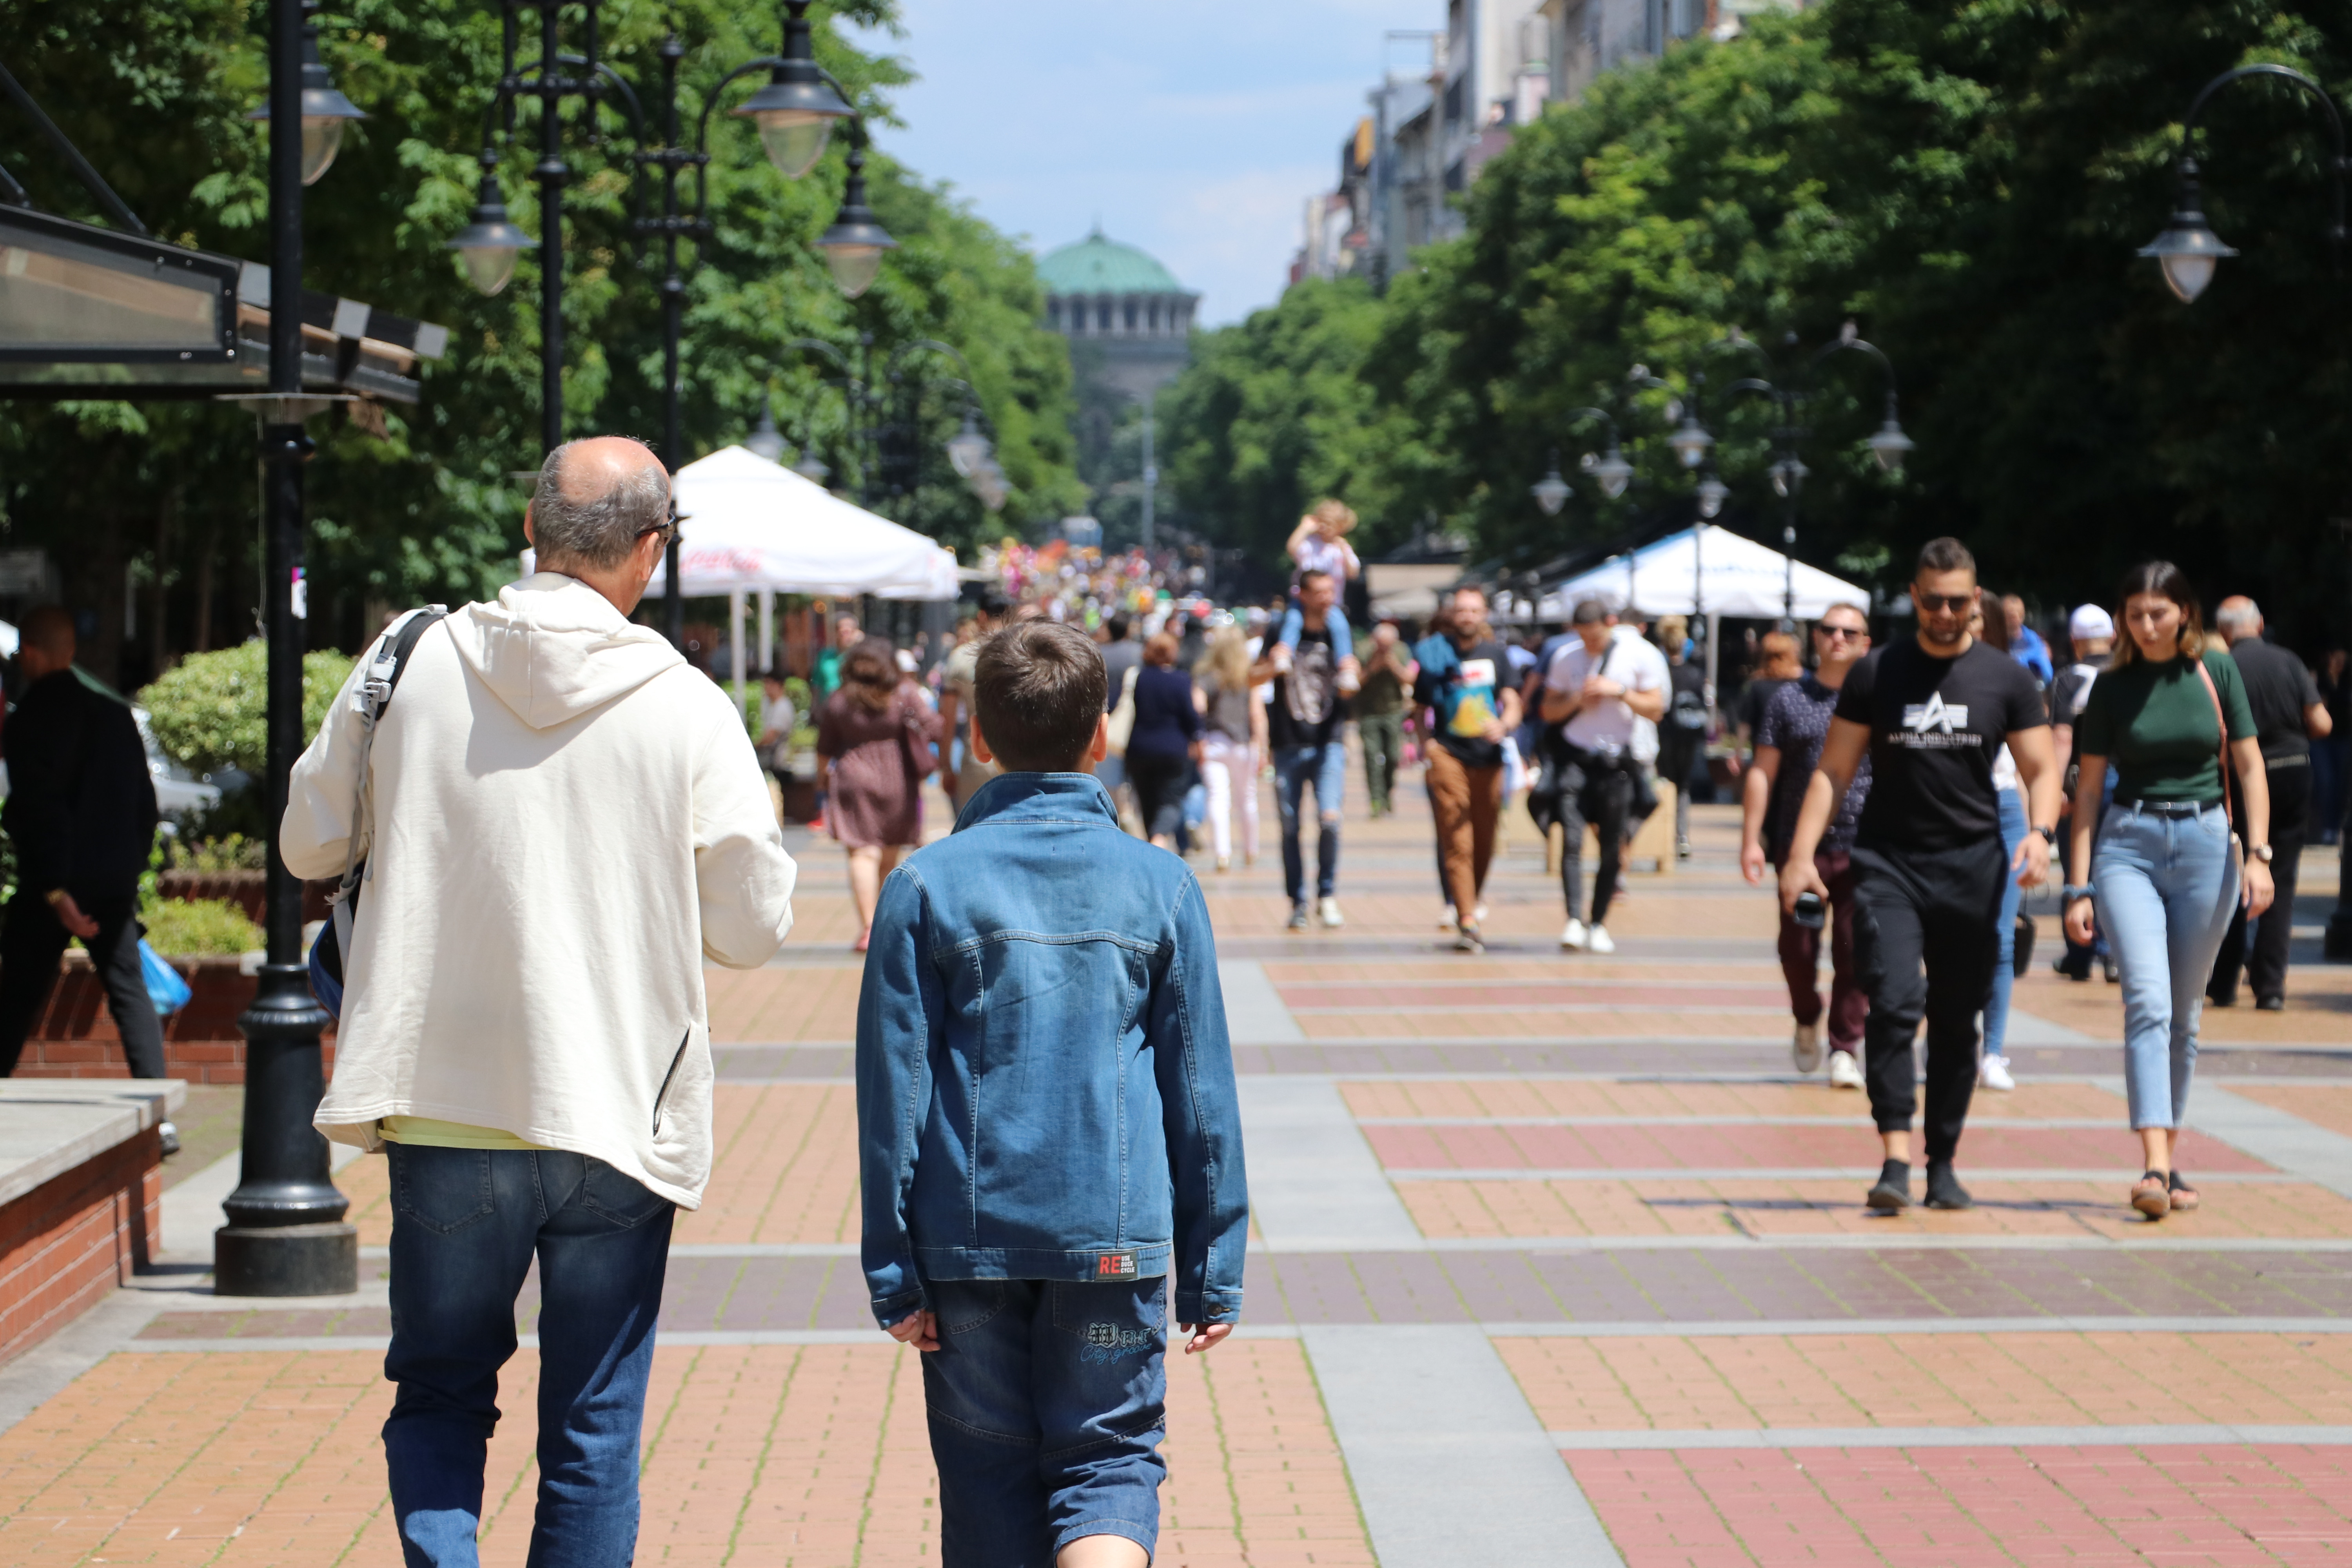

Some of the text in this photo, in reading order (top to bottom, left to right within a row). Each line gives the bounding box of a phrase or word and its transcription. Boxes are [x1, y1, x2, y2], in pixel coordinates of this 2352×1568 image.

[1100, 1256, 1121, 1274] RE
[1080, 1343, 1152, 1365] City groove
